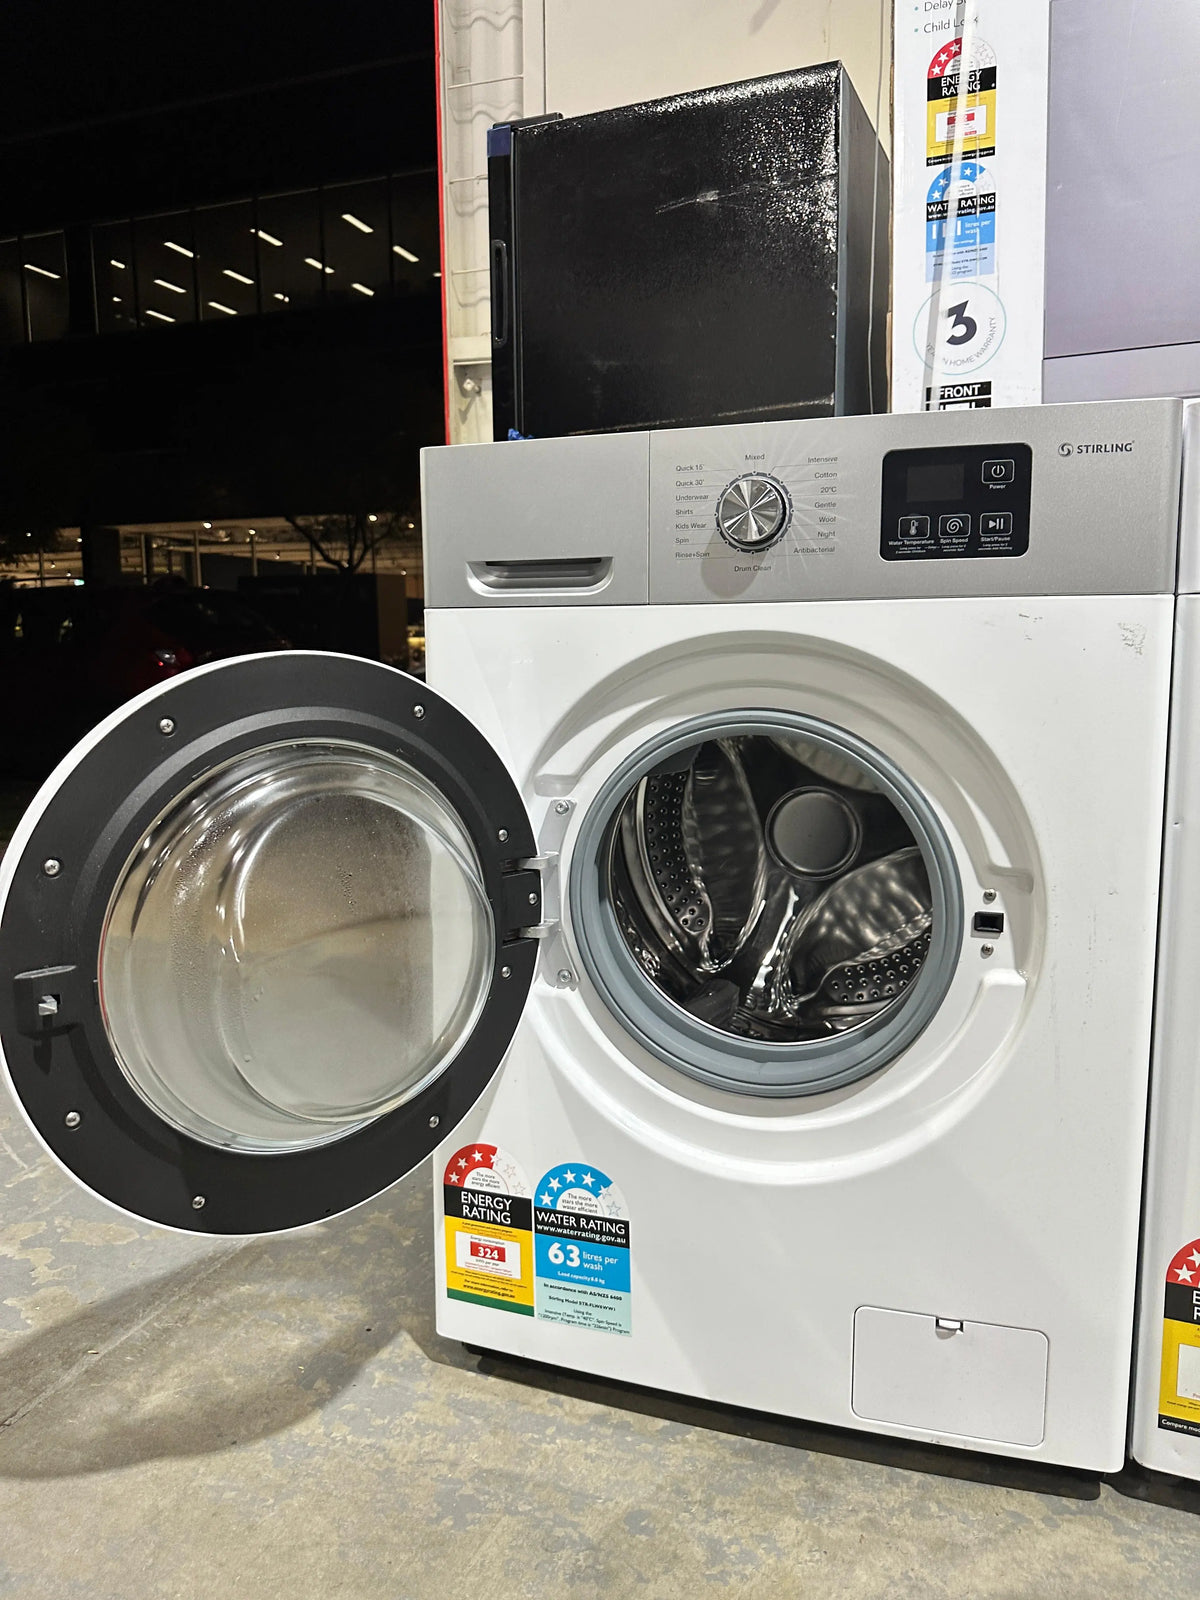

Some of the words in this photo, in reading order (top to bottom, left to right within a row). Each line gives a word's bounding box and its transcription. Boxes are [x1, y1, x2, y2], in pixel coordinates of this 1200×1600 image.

[924, 0, 953, 11] Delay
[923, 18, 950, 34] Child
[941, 70, 982, 87] ENEGY
[946, 299, 977, 346] 3
[973, 316, 998, 359] WARRANTY
[938, 384, 982, 399] FRONT
[1076, 442, 1133, 454] STIRLING
[807, 456, 838, 464] Intensive
[675, 464, 693, 472] Quick
[814, 471, 838, 479] Cotton
[675, 480, 693, 488] Quick
[814, 501, 837, 509] Gentle
[675, 508, 694, 516] Shirts
[675, 522, 690, 530] Kids
[817, 530, 836, 539] Night
[675, 537, 690, 545] Spin
[675, 551, 710, 559] Rinse+Spin
[793, 546, 836, 554] Antibacterial
[461, 1191, 512, 1211] ENERGY
[462, 1204, 511, 1224] RATING
[577, 1206, 598, 1214] efficient
[536, 1210, 577, 1227] WATER
[580, 1217, 625, 1235] RATING
[536, 1224, 626, 1244] www.waterrating.gov.au
[477, 1246, 499, 1260] 324
[548, 1242, 581, 1267] 63
[582, 1251, 602, 1262] litres
[604, 1256, 618, 1265] per
[583, 1262, 603, 1271] wash
[570, 1273, 591, 1282] capacity
[549, 1284, 577, 1293] accordance
[1161, 1418, 1188, 1430] Compare
